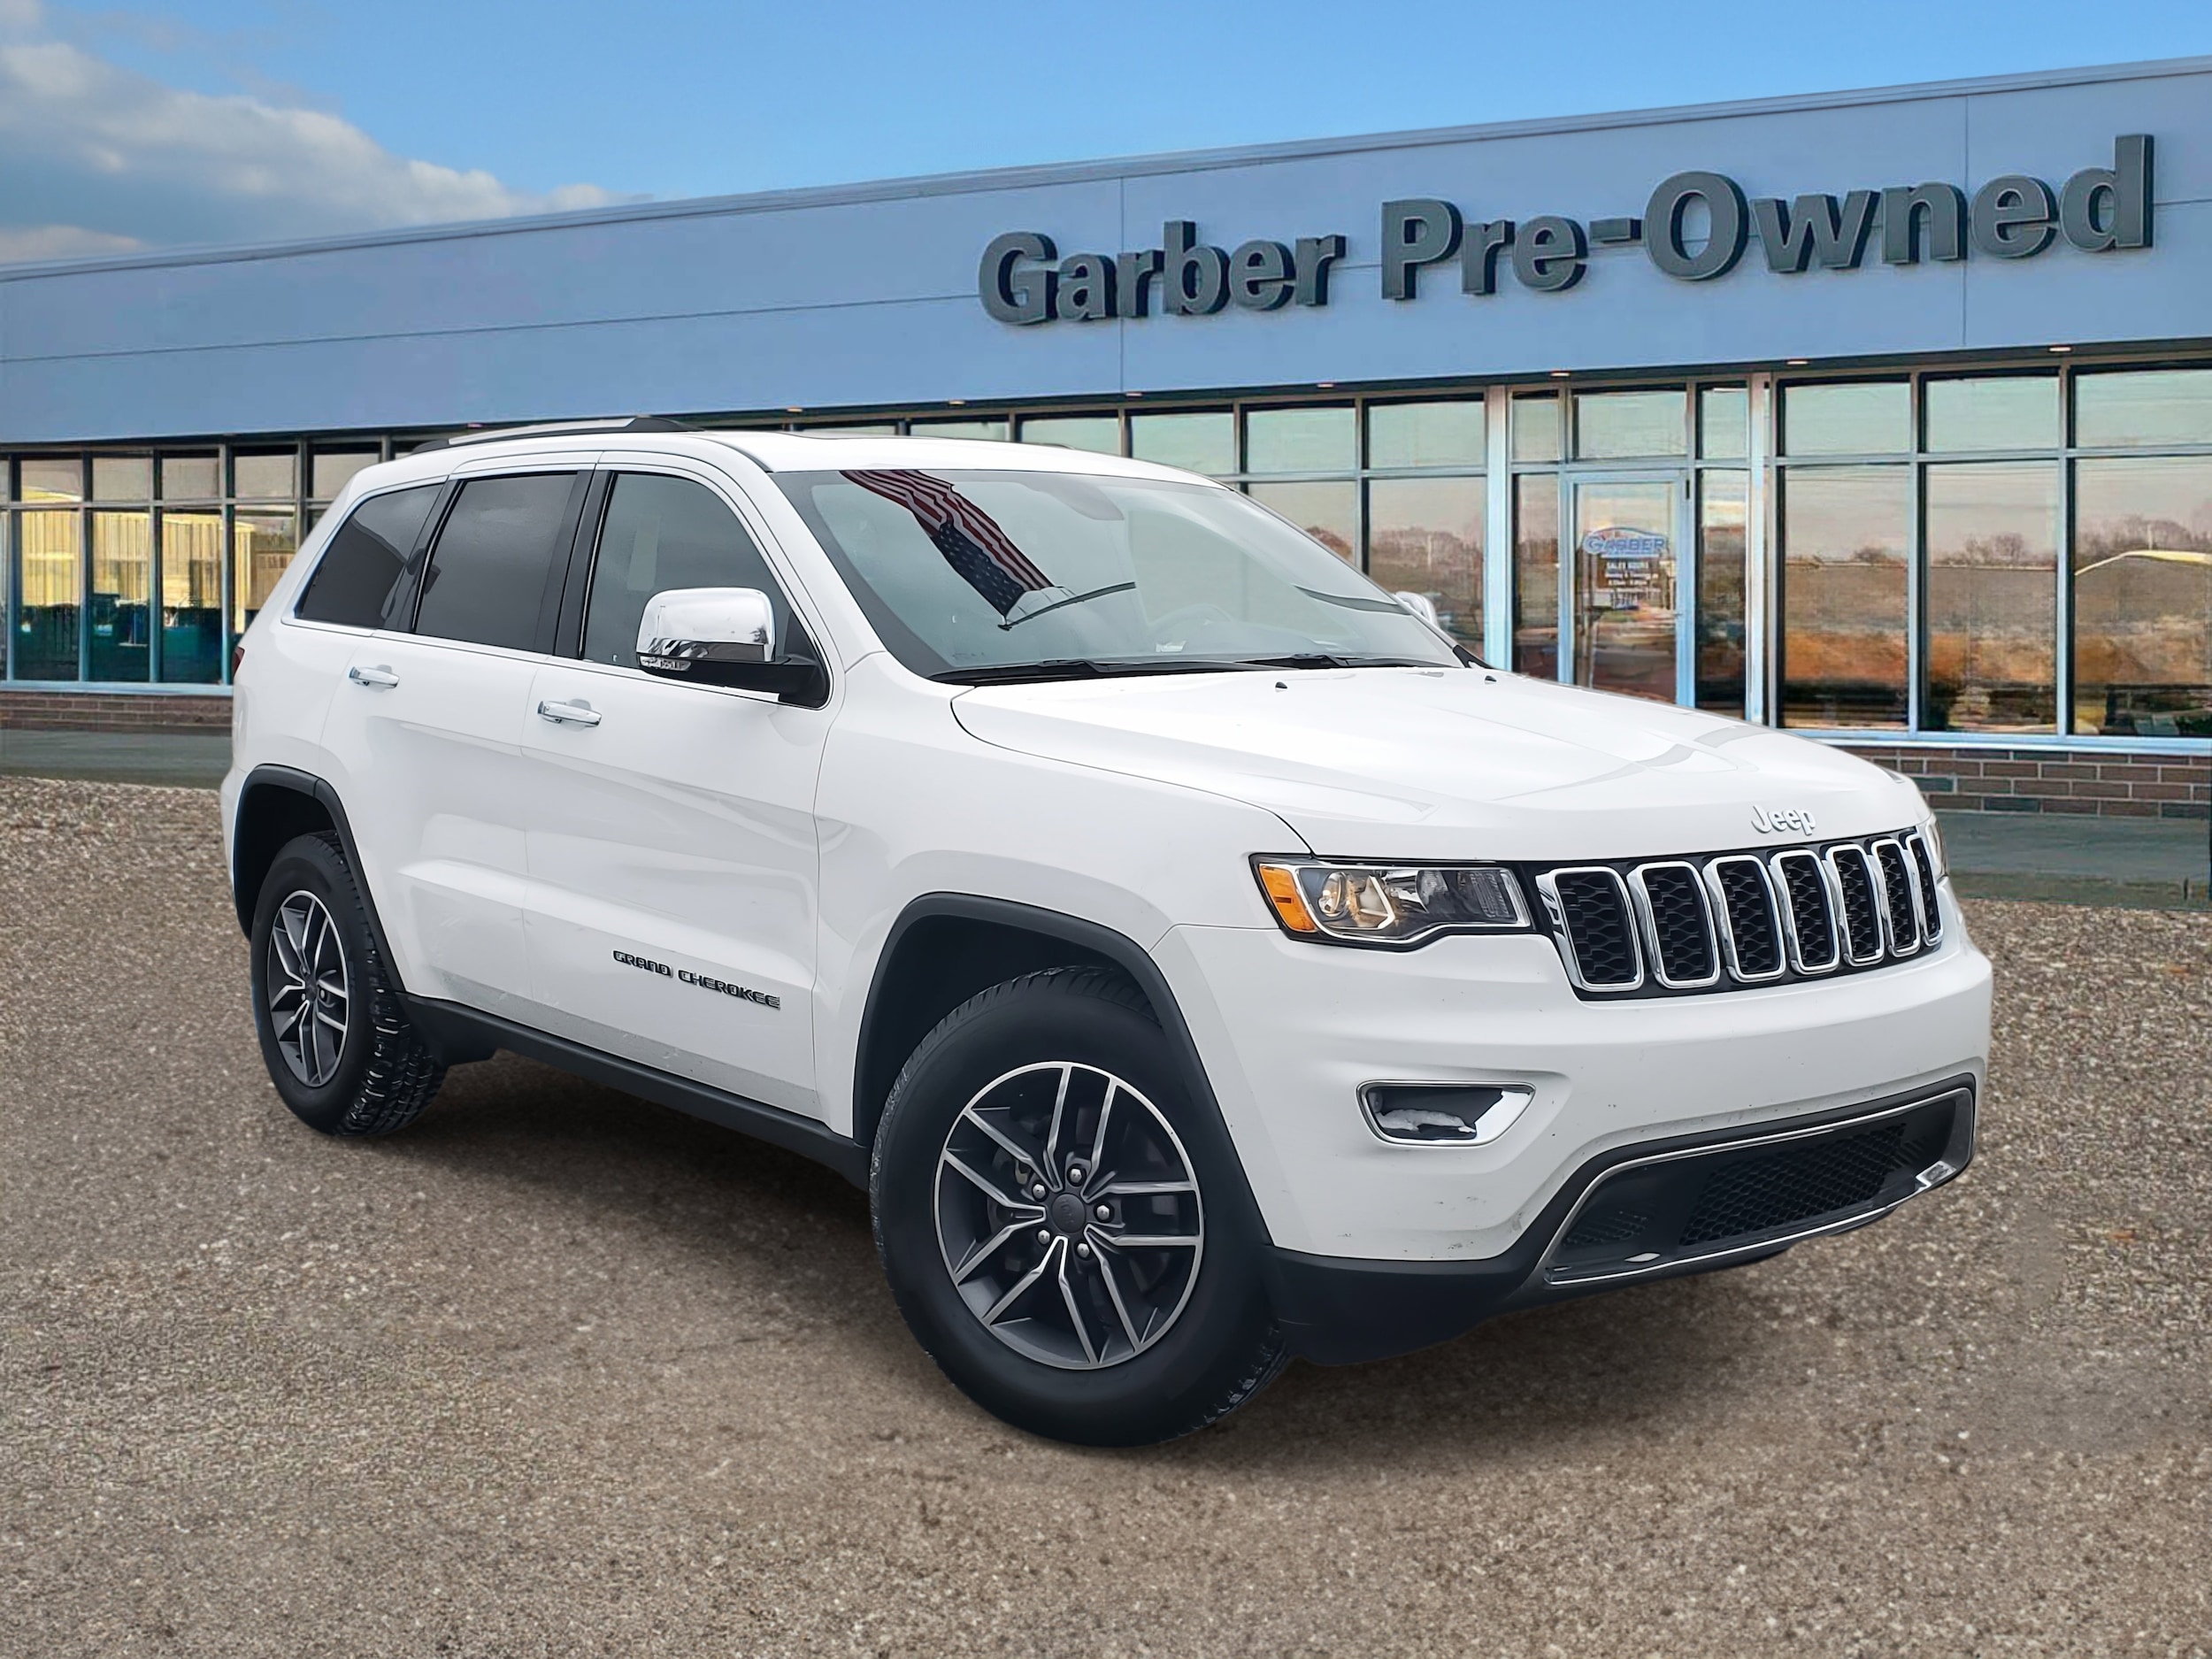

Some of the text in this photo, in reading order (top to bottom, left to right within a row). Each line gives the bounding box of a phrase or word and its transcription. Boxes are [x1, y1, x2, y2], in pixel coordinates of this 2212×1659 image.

[979, 134, 2154, 326] Garber Pre-Owned
[1751, 804, 1816, 836] Jeep
[612, 949, 781, 1010] GRAND CHEROKEE
